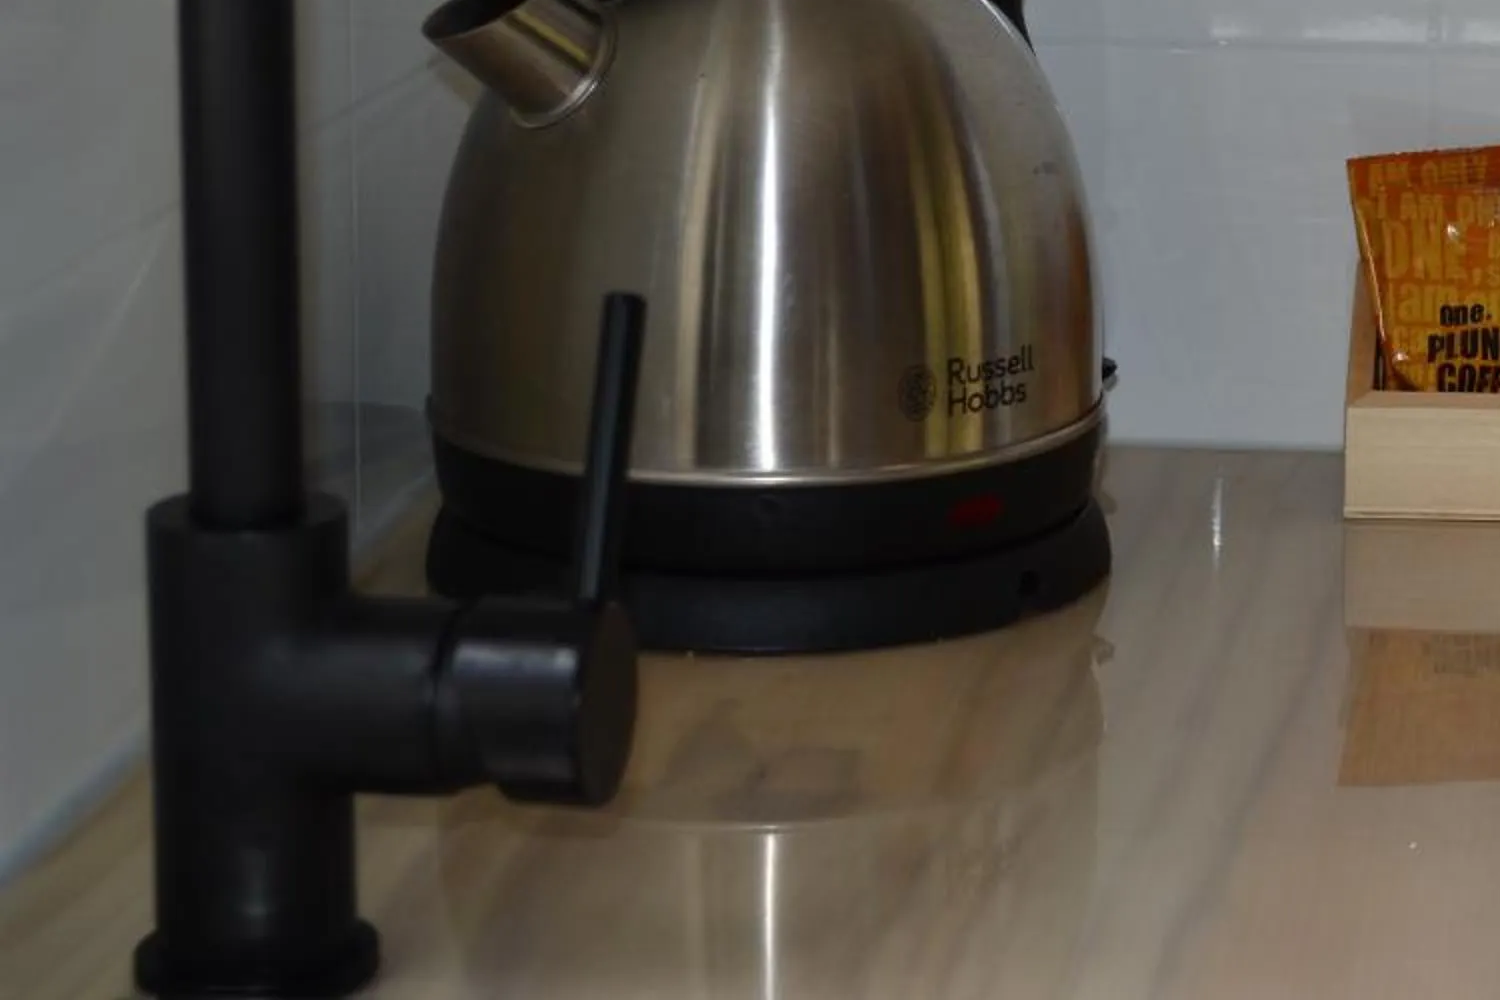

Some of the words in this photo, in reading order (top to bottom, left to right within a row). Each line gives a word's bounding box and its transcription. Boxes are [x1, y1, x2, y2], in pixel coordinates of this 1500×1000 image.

[1440, 303, 1493, 327] one.
[947, 344, 1035, 386] Russell
[947, 380, 1027, 419] Hobbs
